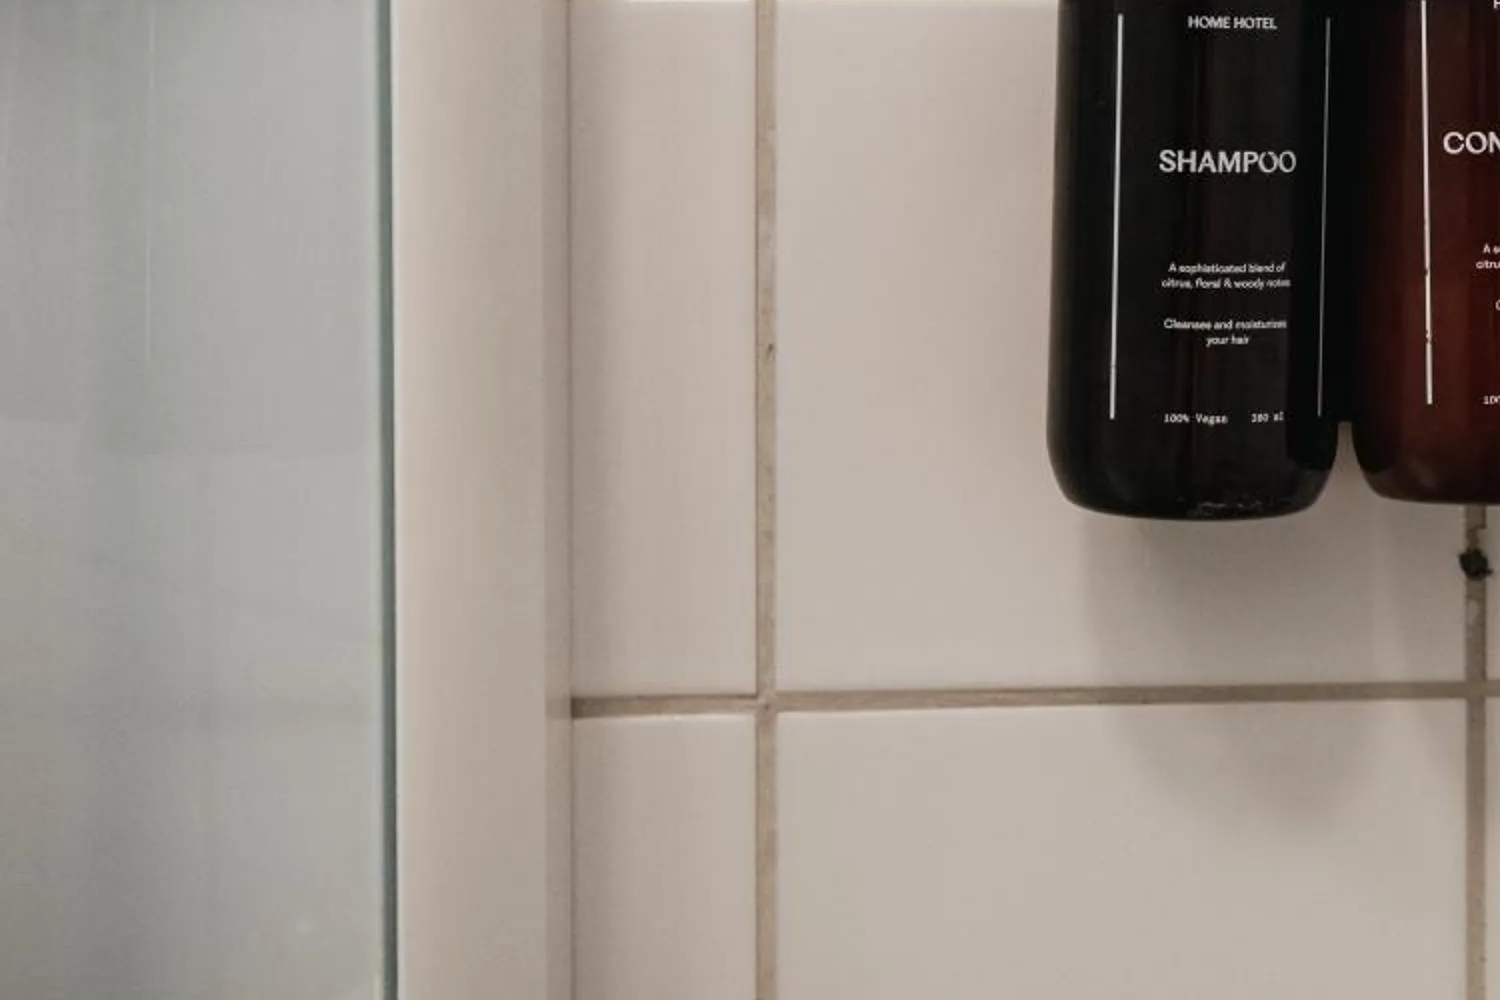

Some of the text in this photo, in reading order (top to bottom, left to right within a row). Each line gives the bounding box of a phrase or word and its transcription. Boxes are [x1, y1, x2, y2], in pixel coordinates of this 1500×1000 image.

[1187, 16, 1277, 29] HOME HOTEL
[1159, 149, 1296, 173] SHAMPOO
[1483, 244, 1491, 253] A
[1168, 261, 1287, 275] A sophisticated blend of
[1195, 277, 1221, 288] floral
[1223, 278, 1232, 289] &
[1233, 278, 1264, 291] woody
[1213, 319, 1234, 330] and
[1205, 334, 1249, 347] your hair
[1164, 412, 1229, 426] 100% Vegan
